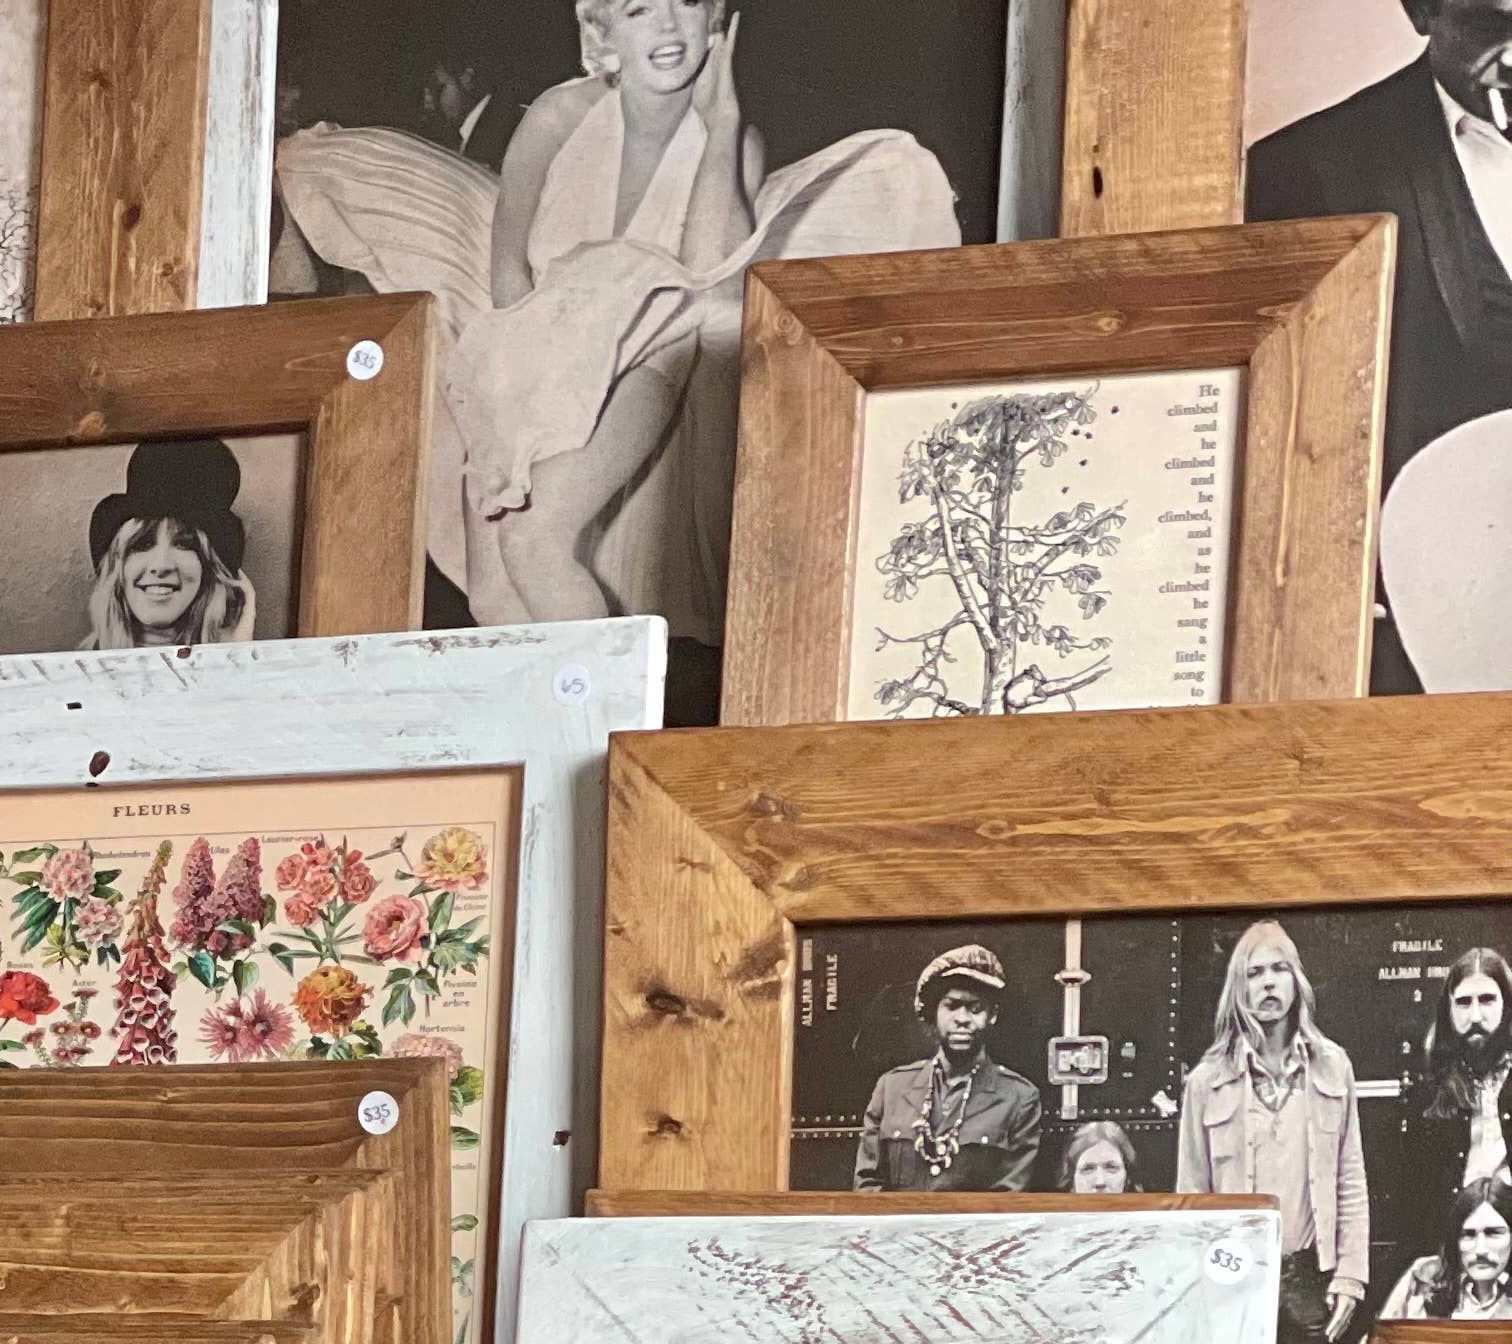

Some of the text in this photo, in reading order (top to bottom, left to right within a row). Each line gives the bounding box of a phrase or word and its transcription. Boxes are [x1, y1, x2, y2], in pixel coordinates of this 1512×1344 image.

[1198, 383, 1220, 398] He
[1166, 401, 1219, 417] climbed
[1191, 419, 1218, 433] and
[1200, 437, 1217, 450] he
[1164, 455, 1216, 471] climbed
[1190, 472, 1215, 486] and
[1198, 490, 1214, 504] he
[1157, 508, 1213, 524] climbed,
[1186, 525, 1213, 540] and
[1197, 546, 1212, 557] as
[1194, 561, 1212, 575] he
[1158, 578, 1210, 594] climbed
[1192, 597, 1209, 610] he
[1176, 617, 1209, 630] sang
[1198, 635, 1208, 645] a
[1175, 649, 1207, 664] little
[1173, 670, 1206, 683] song
[1190, 686, 1205, 698] to
[112, 803, 191, 817] FLEURS
[363, 1104, 390, 1122] $35
[1210, 1249, 1242, 1272] $35
